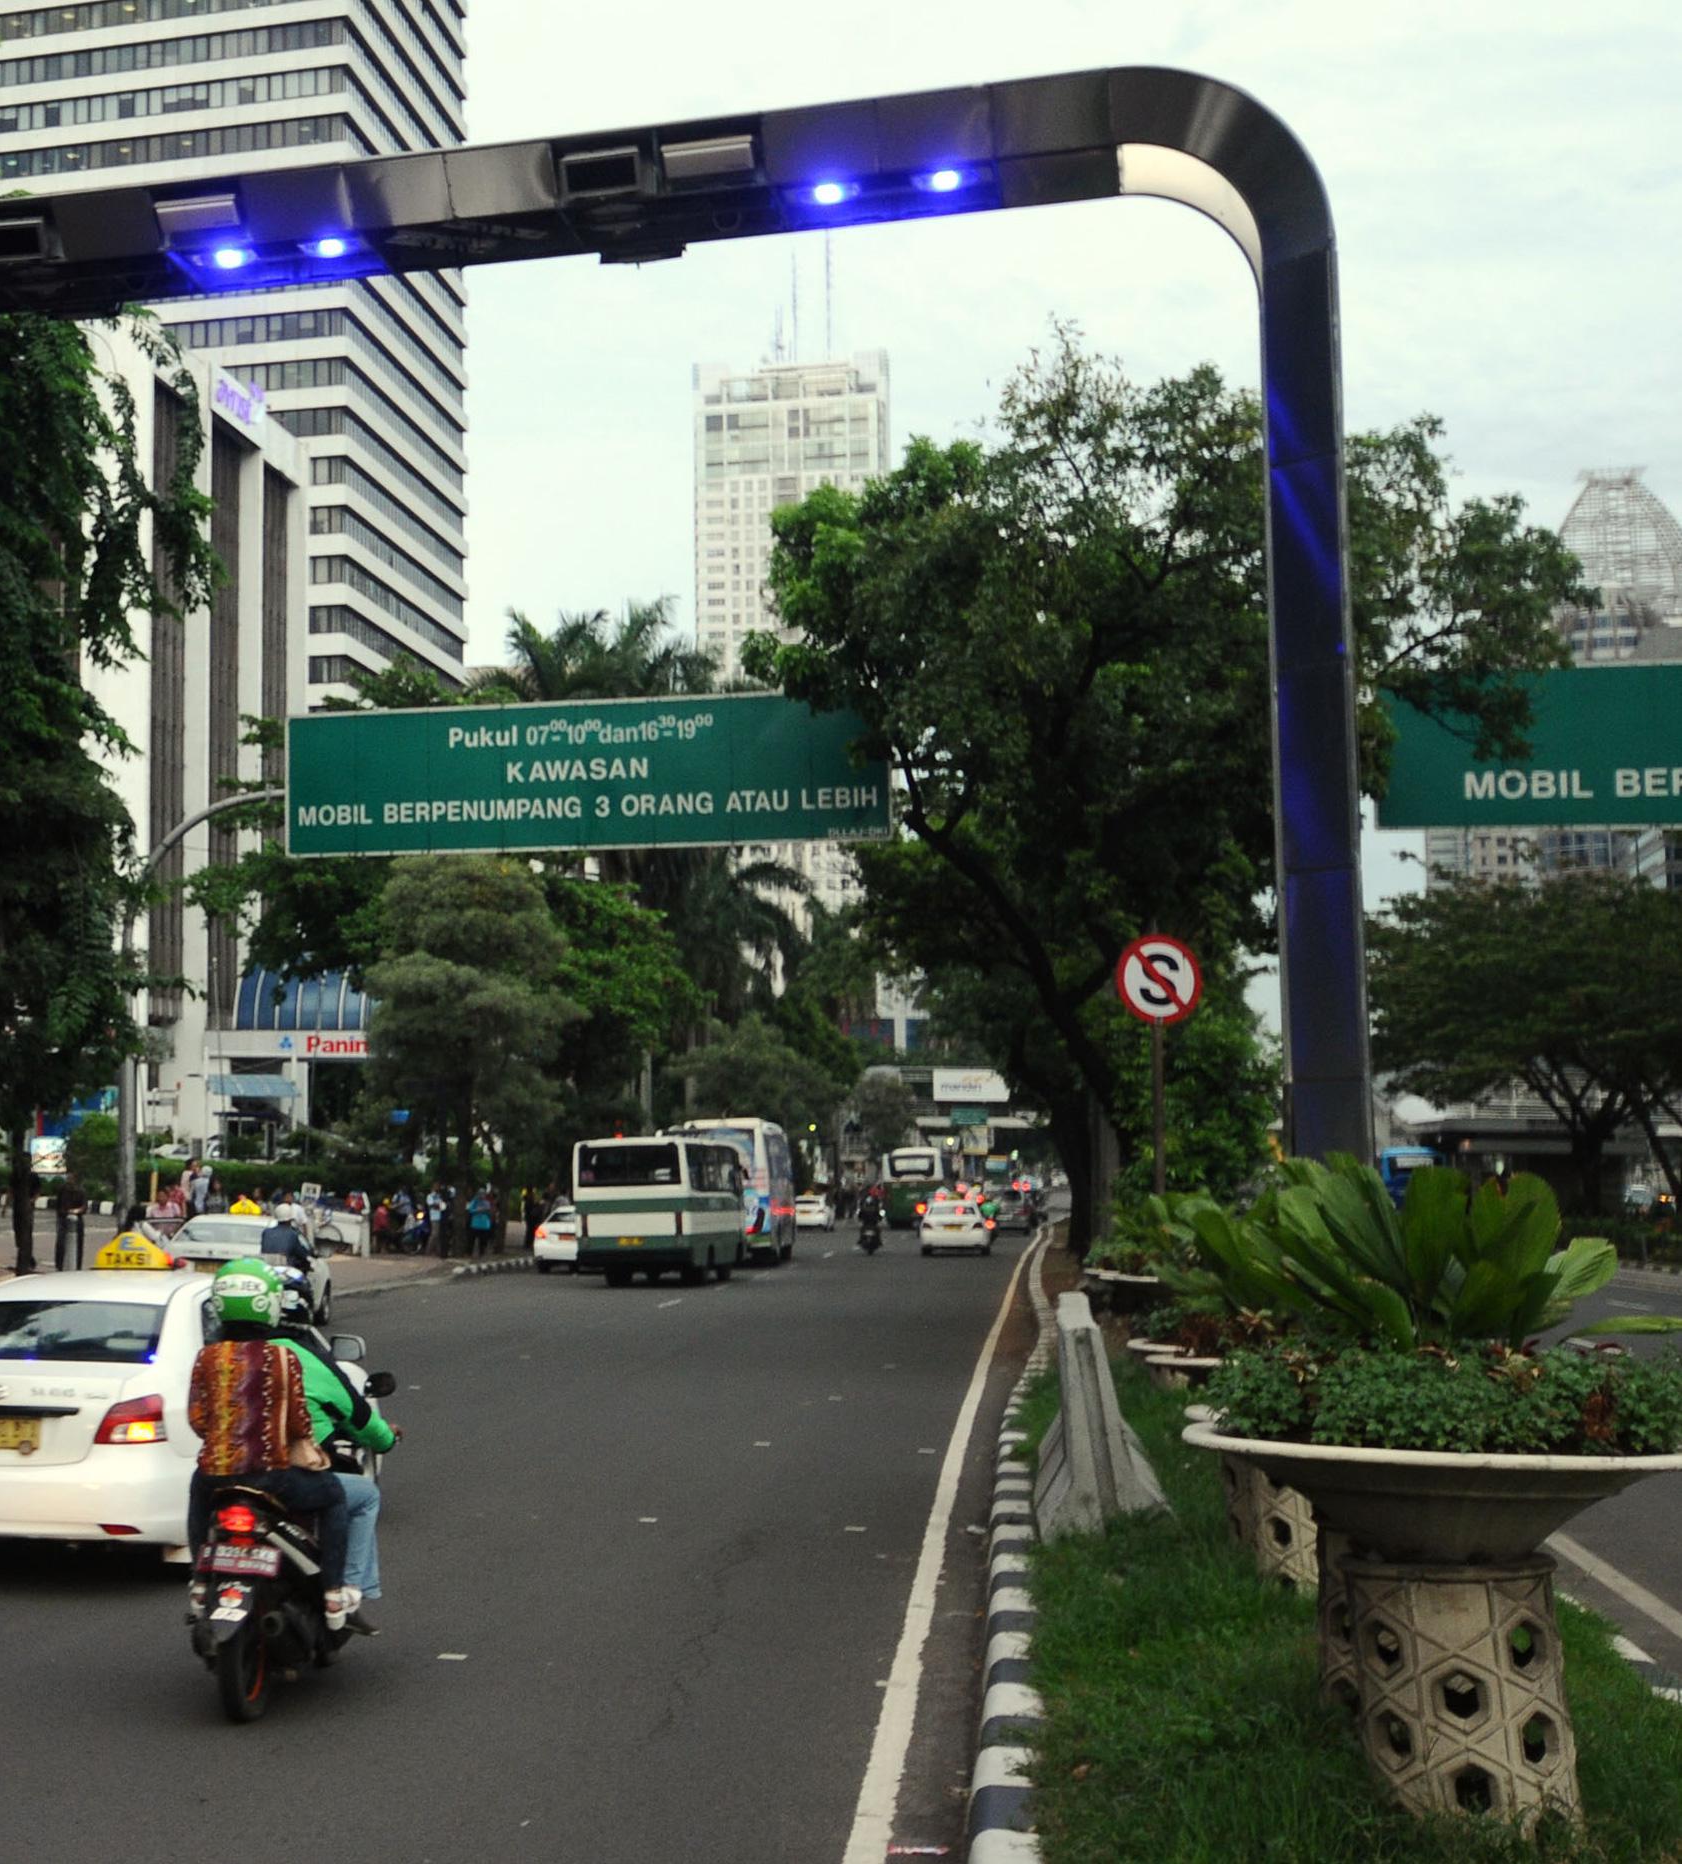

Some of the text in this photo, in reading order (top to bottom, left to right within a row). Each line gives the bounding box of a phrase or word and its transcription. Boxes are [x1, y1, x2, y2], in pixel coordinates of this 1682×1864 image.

[448, 725, 518, 748] Pukul
[506, 757, 649, 783] KAWASAN
[1464, 769, 1594, 800] MOBIL
[298, 786, 878, 826] MOBIL BERPENUMPANG 3 ORANG ATAU LEBIH
[1139, 952, 1180, 1006] S
[306, 1035, 370, 1053] Panin
